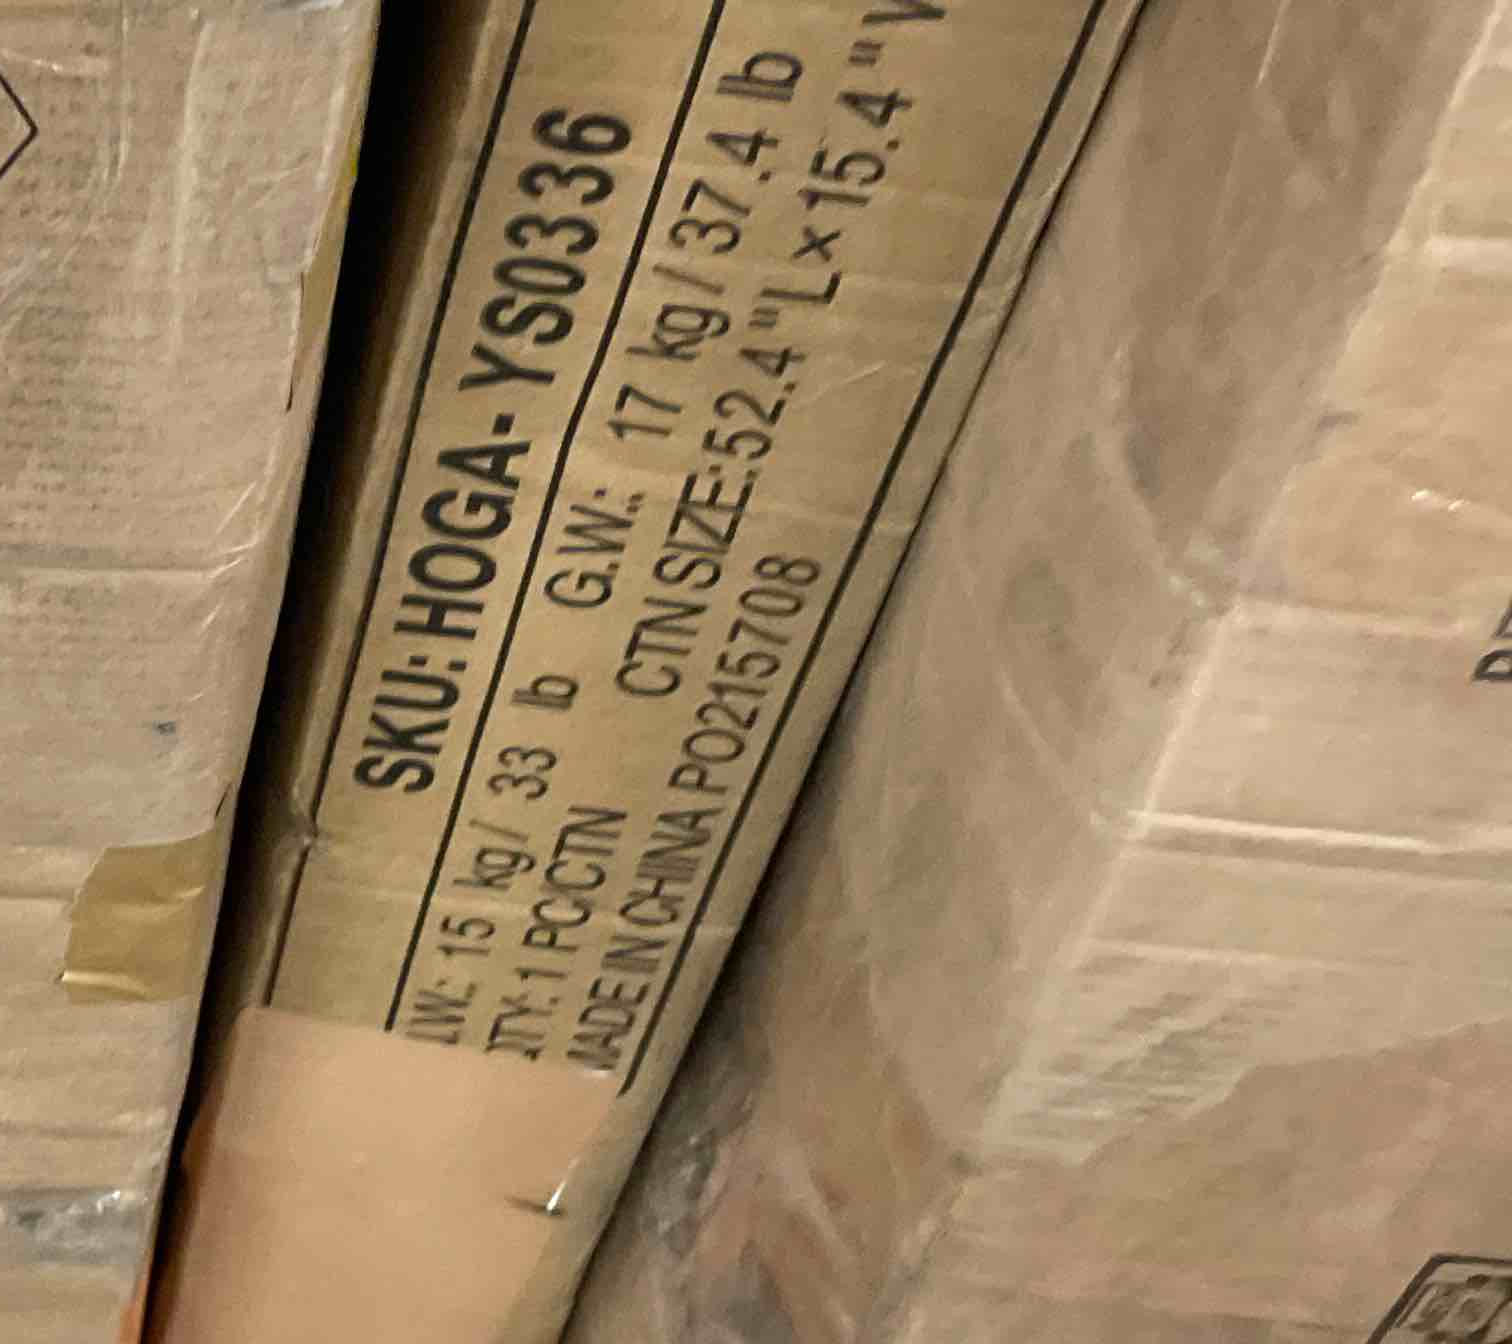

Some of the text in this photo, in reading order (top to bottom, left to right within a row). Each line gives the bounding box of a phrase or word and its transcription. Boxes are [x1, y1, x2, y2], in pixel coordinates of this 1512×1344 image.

[715, 51, 803, 102] lb
[606, 384, 683, 440] 17
[511, 674, 578, 709] lb
[488, 746, 556, 801] 33
[516, 968, 567, 981] 1
[614, 597, 708, 698] CTN
[618, 807, 724, 927] CHINA
[436, 917, 495, 959] 15
[601, 934, 668, 974] IN
